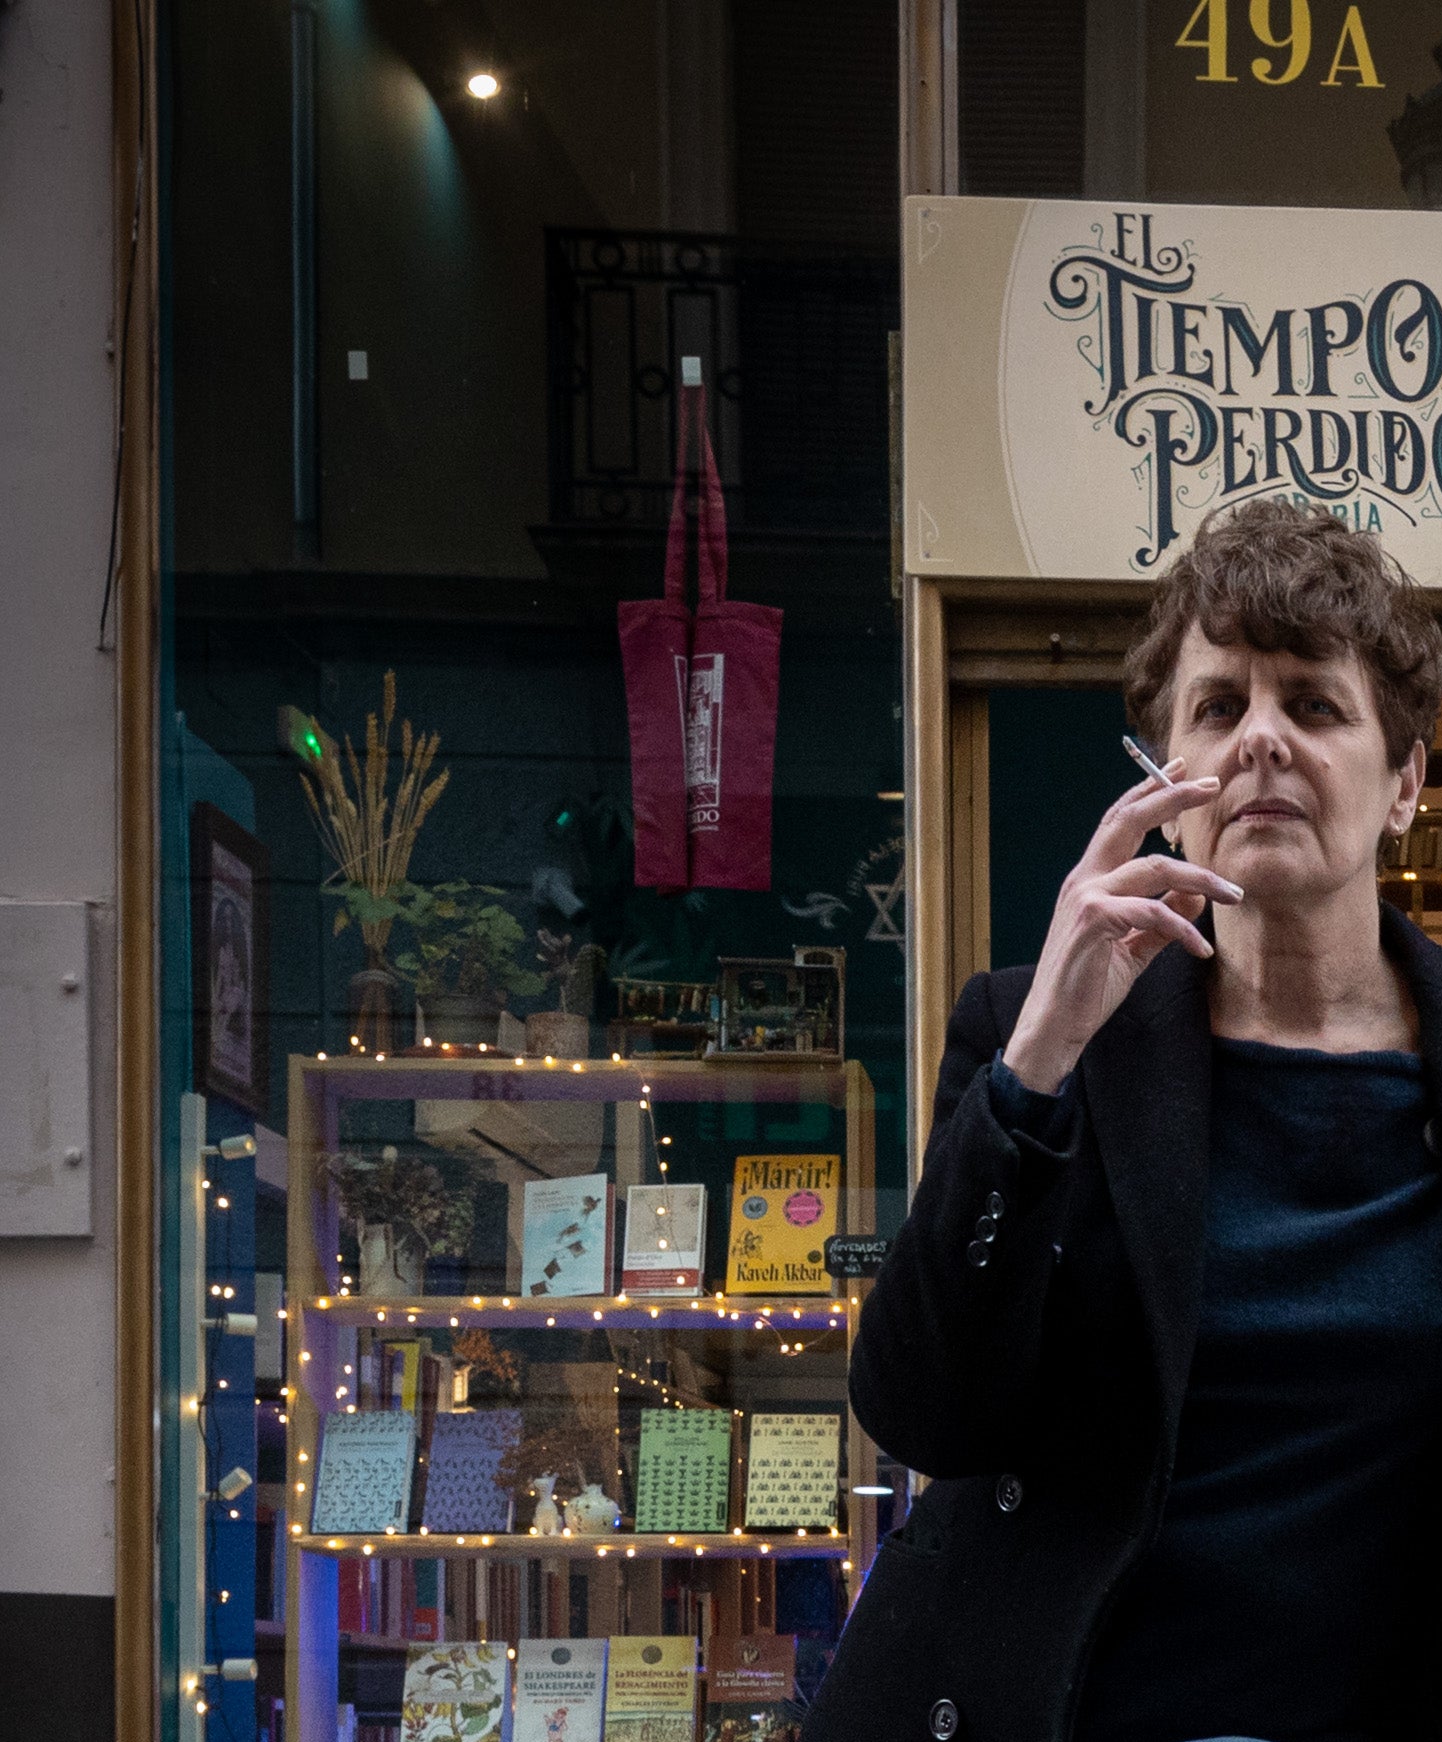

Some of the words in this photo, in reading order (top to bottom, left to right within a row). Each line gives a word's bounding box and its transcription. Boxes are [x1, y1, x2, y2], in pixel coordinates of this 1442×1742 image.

[1111, 211, 1185, 275] EL
[741, 1160, 832, 1196] ¡Mártir!
[737, 1263, 779, 1281] Kaveh
[784, 1263, 824, 1281] Akbar
[536, 1671, 583, 1680] LONDRES
[585, 1671, 596, 1679] de
[626, 1670, 675, 1678] FLORENCIA
[524, 1681, 596, 1690] SHAKESPEARE
[615, 1681, 688, 1689] RENACIMIENTO
